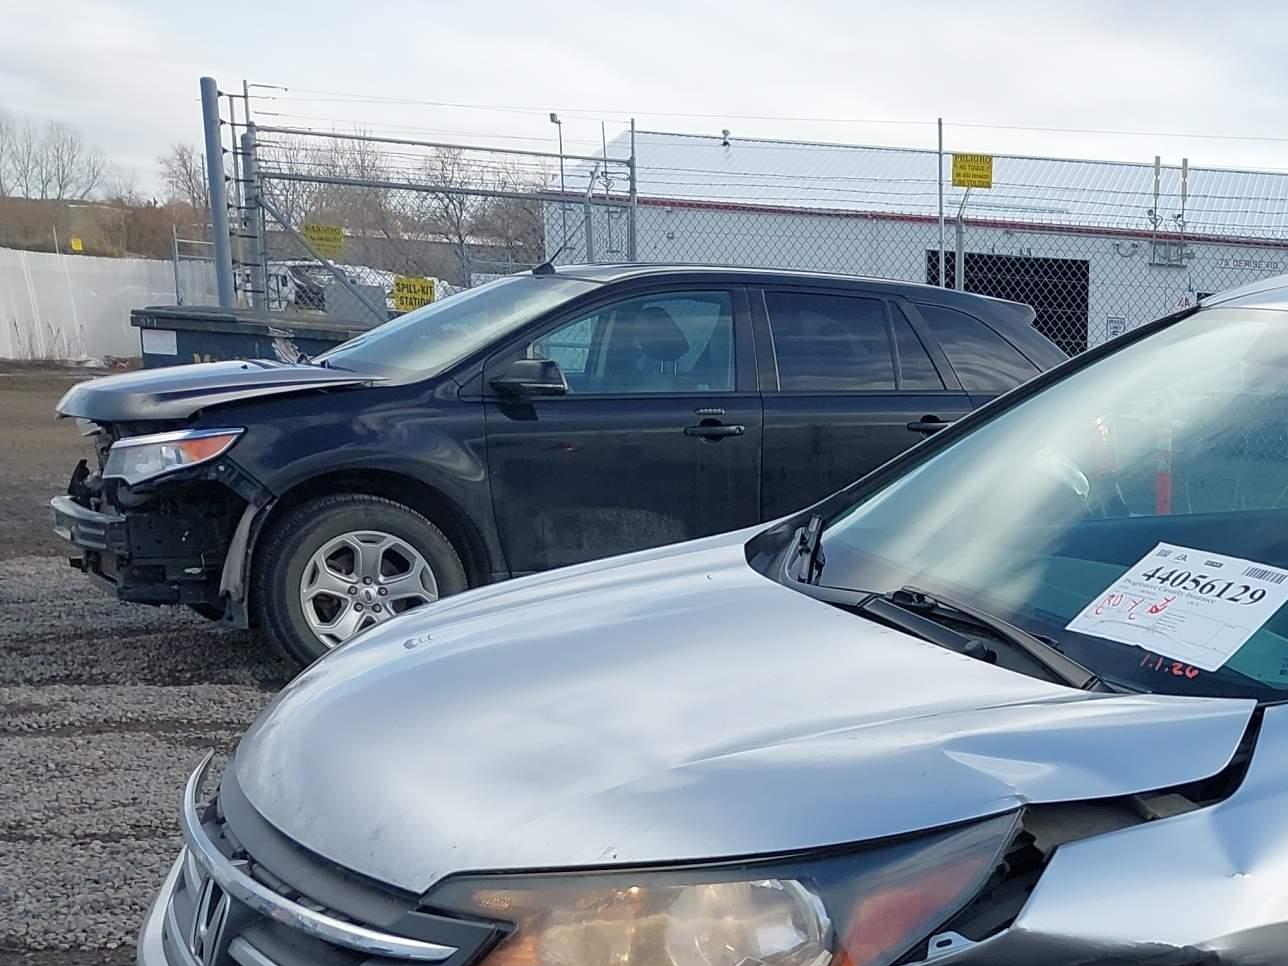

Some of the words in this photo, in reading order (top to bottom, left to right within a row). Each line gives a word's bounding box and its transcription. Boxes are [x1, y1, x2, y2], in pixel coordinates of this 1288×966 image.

[304, 224, 342, 236] WARNING
[396, 281, 433, 296] SPILL-KIT
[1142, 566, 1267, 605] 44056129
